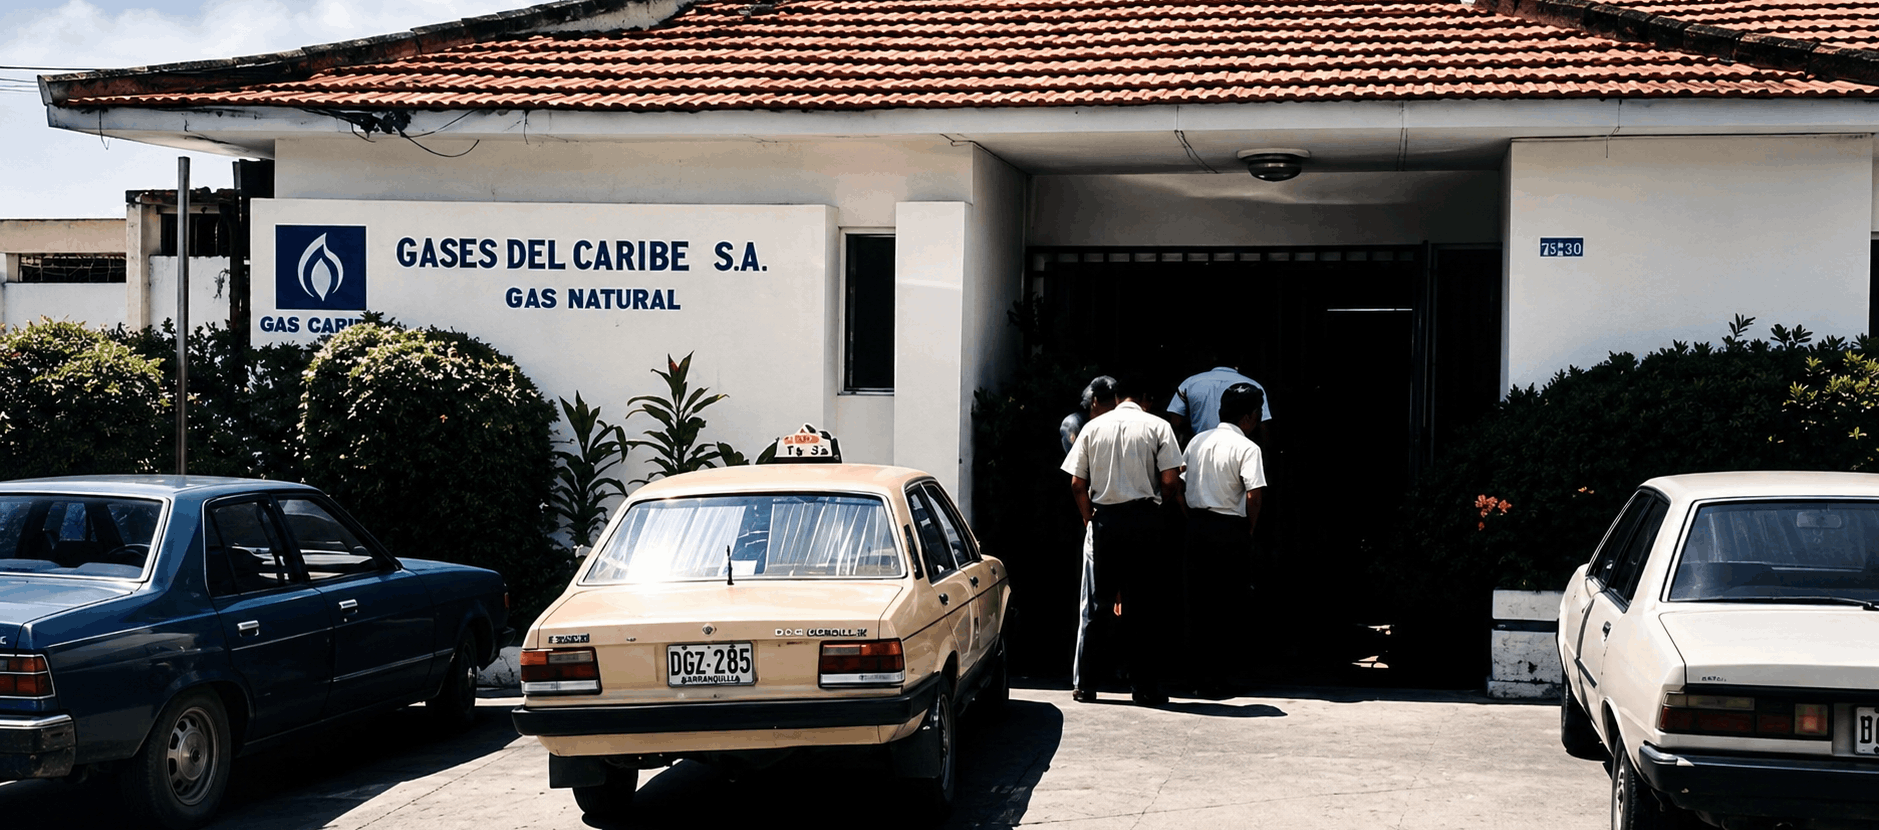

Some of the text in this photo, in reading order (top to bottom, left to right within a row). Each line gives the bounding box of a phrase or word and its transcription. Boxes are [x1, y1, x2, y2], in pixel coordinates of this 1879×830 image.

[396, 237, 768, 272] GASES DEL CARIBE S.A.
[505, 287, 681, 310] GAS NATURAL
[259, 316, 300, 333] GAS
